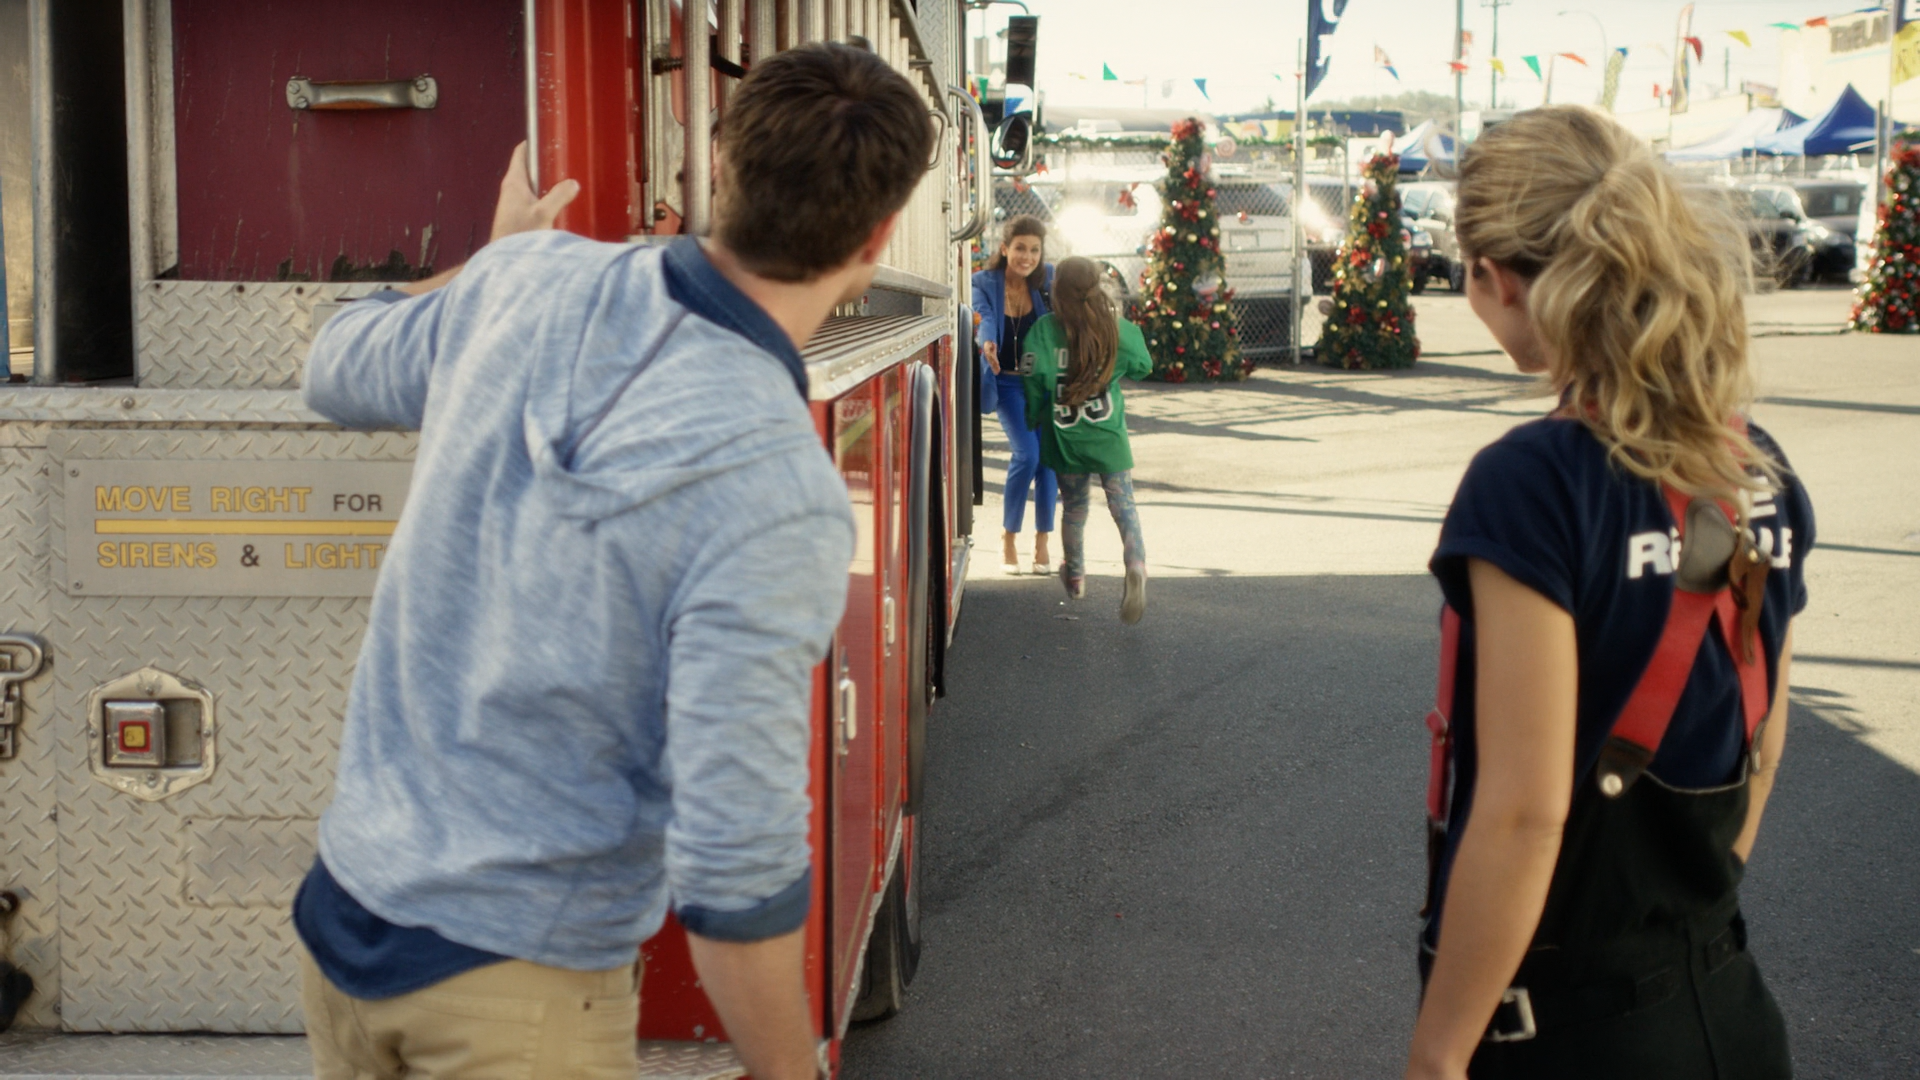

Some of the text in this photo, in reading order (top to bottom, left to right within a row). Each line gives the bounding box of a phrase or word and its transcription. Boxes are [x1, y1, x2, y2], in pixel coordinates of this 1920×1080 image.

[95, 486, 382, 513] MOVE RIGHT FOR
[97, 542, 386, 569] SIRENS & LIGHT
